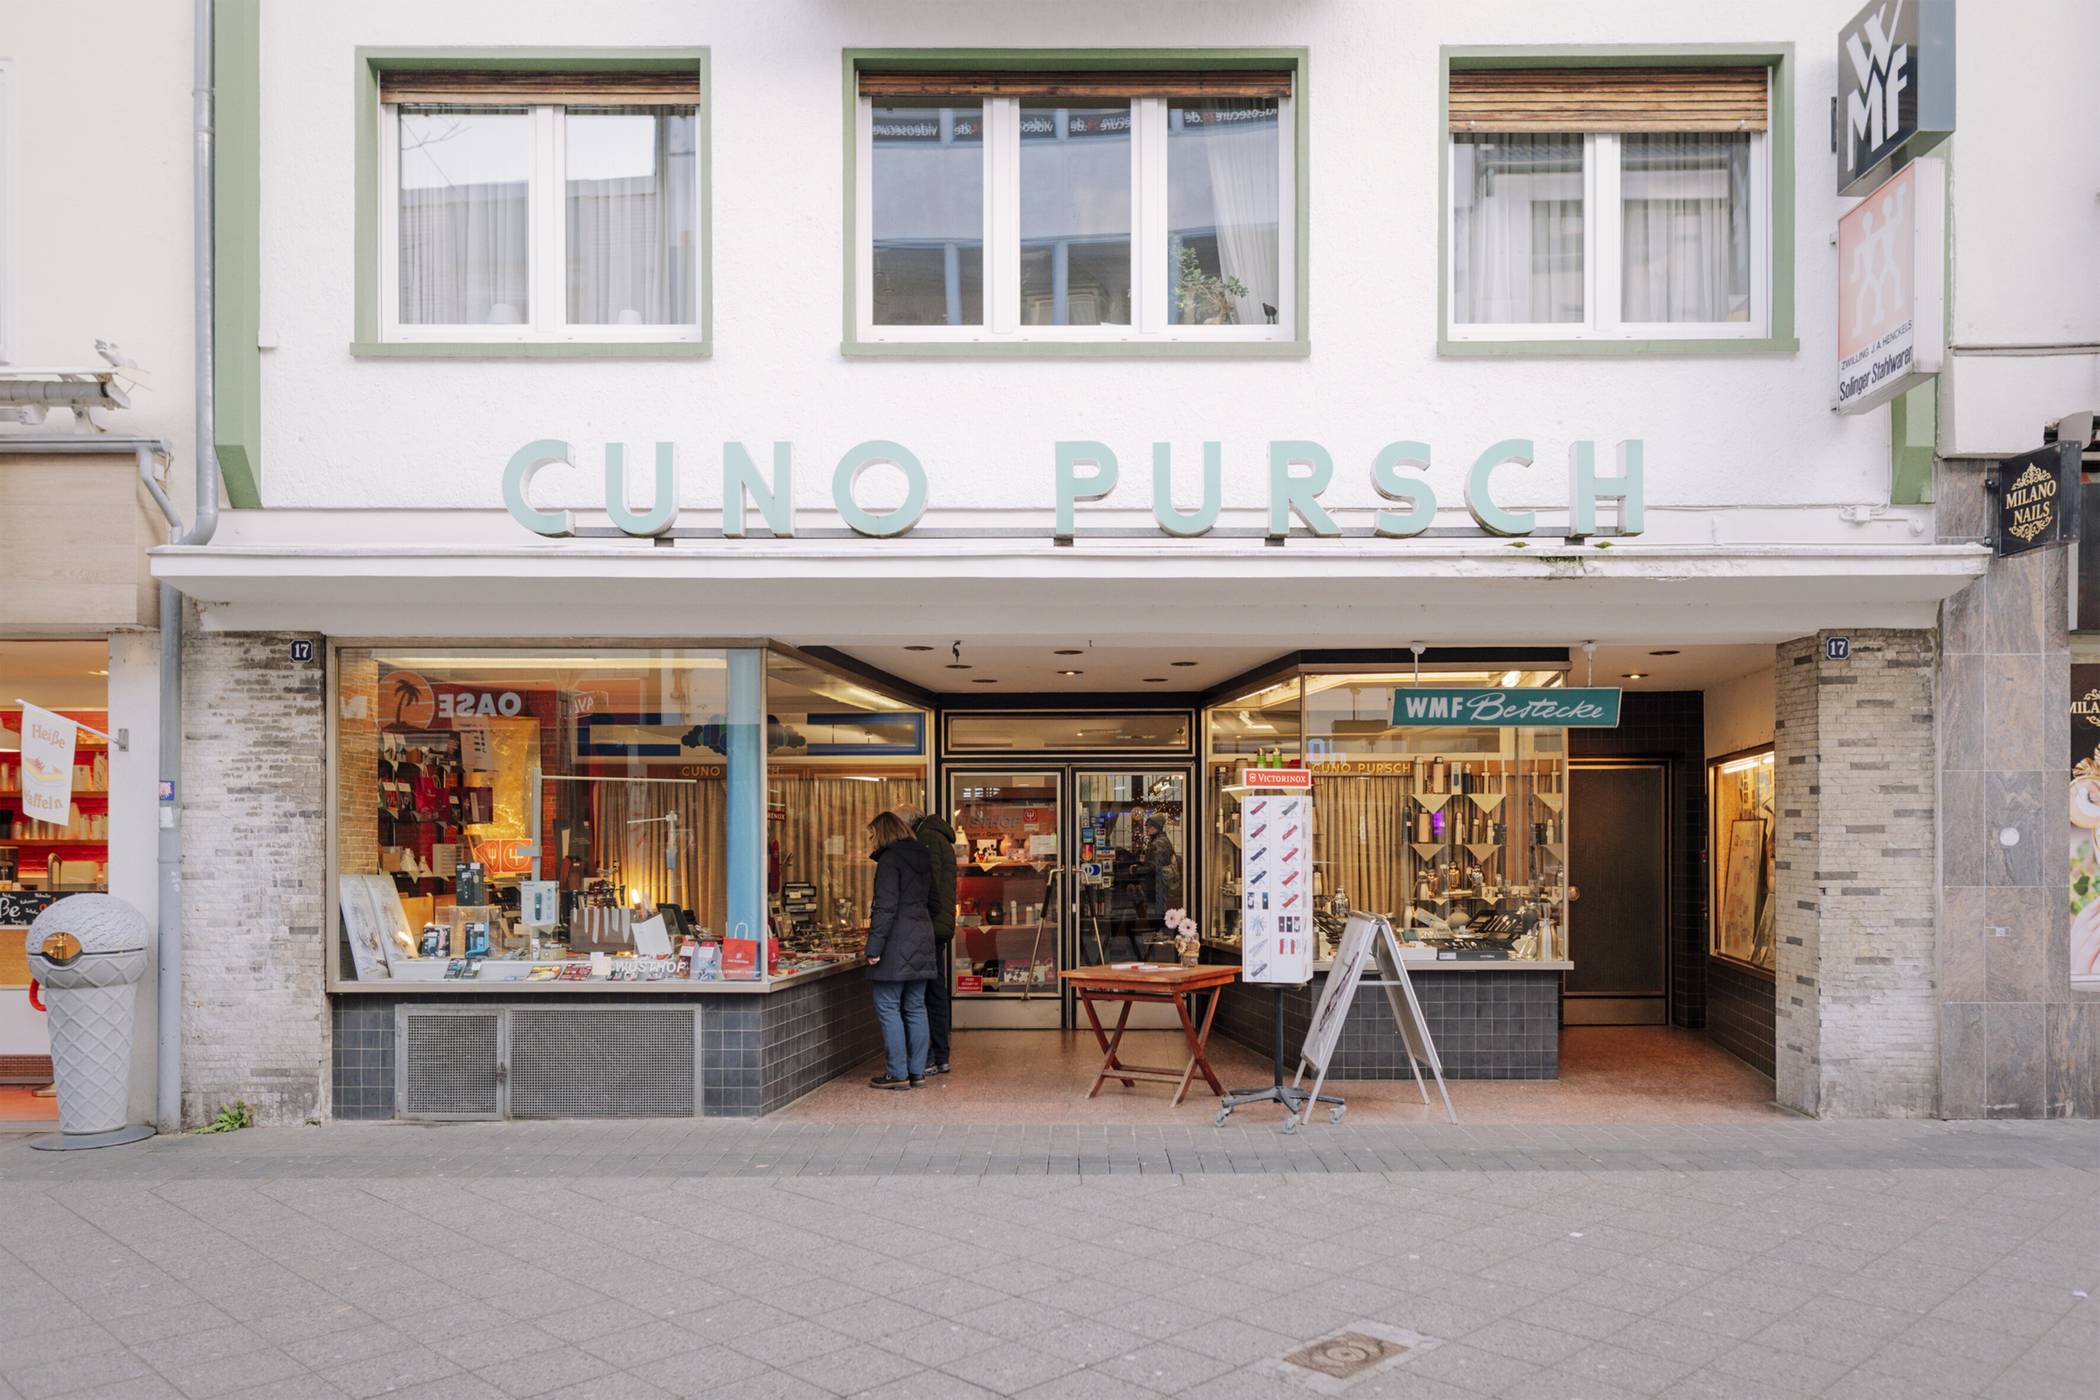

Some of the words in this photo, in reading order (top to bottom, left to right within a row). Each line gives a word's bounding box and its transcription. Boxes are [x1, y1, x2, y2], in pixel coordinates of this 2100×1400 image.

[1846, 0, 1907, 172] WMF
[1841, 347, 1869, 370] ZWILLING
[1882, 319, 1913, 347] HENCKELS
[1839, 371, 1871, 402] Solinger
[502, 438, 928, 538] CUNO
[1055, 438, 1644, 538] PURSCH
[2005, 480, 2057, 510] MILANO
[2013, 501, 2051, 526] NAILS
[295, 643, 310, 658] 17
[1829, 640, 1846, 656] 17
[1406, 697, 1463, 719] WMF
[1466, 692, 1604, 721] Bestecke
[32, 724, 66, 749] Heiße
[681, 765, 721, 777] CUNO
[1258, 773, 1306, 783] VICTORINOX
[1312, 763, 1351, 774] CUNO
[1358, 763, 1411, 774] PURSCH
